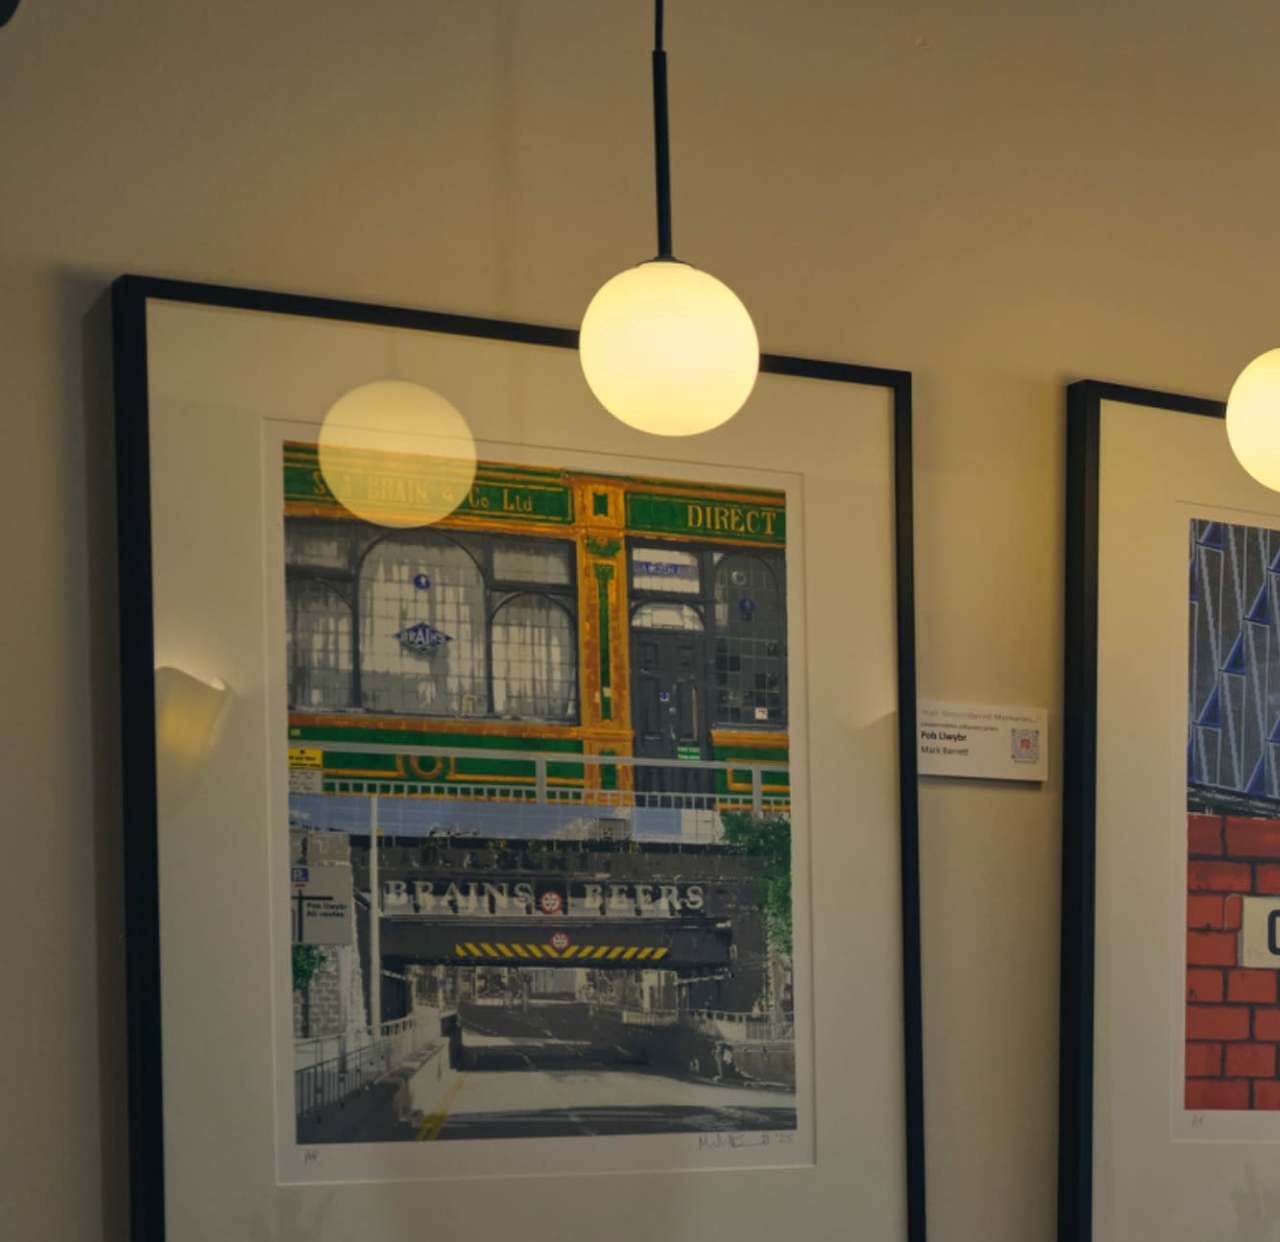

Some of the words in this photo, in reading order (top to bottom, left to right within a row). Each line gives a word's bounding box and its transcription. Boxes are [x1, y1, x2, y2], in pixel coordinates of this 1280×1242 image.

[468, 486, 490, 509] Co
[502, 488, 533, 513] Ltd
[686, 503, 777, 535] DIRECT
[384, 879, 534, 912] BRAINS
[584, 884, 705, 911] BEERS
